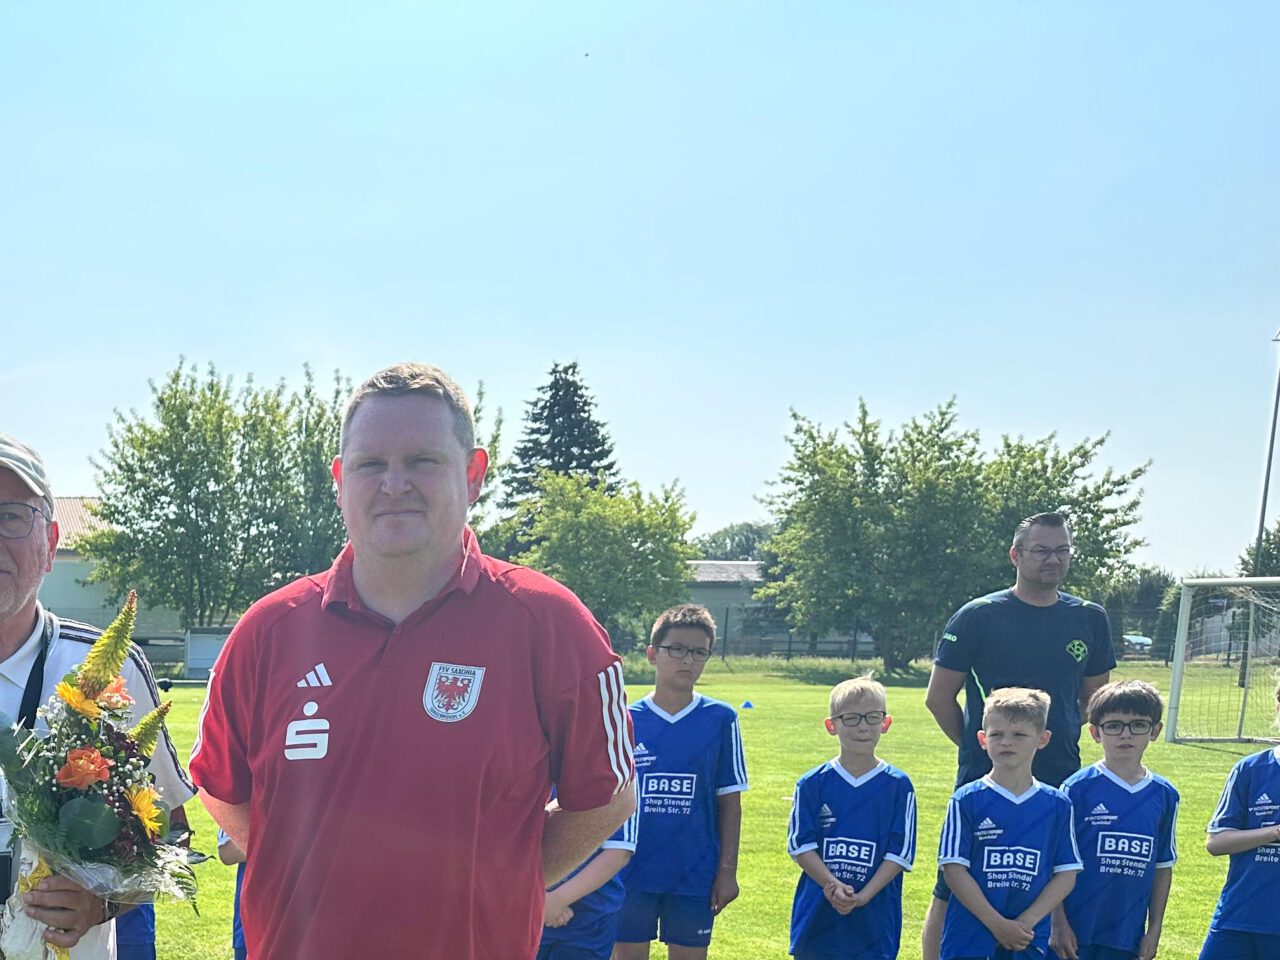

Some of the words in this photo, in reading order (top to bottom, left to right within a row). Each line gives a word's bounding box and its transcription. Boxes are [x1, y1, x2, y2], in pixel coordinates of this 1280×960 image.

[451, 667, 476, 676] SAXONIA
[648, 778, 692, 793] BASE
[645, 798, 662, 806] Shop
[664, 798, 692, 807] Stendal
[667, 806, 681, 814] Str.
[683, 807, 691, 815] 72
[1104, 837, 1150, 855] BASE
[828, 843, 871, 860] BASE
[1256, 847, 1276, 855] Shop
[990, 852, 1035, 868] BASE
[1100, 857, 1120, 866] Shop
[1121, 859, 1147, 869] Stendal
[1255, 854, 1279, 863] Breite
[840, 863, 868, 874] Stendal
[1123, 867, 1136, 876] Str.
[1137, 870, 1145, 878] 72
[856, 873, 866, 882] 72
[987, 872, 1007, 881] Shop
[1021, 882, 1031, 891] 72
